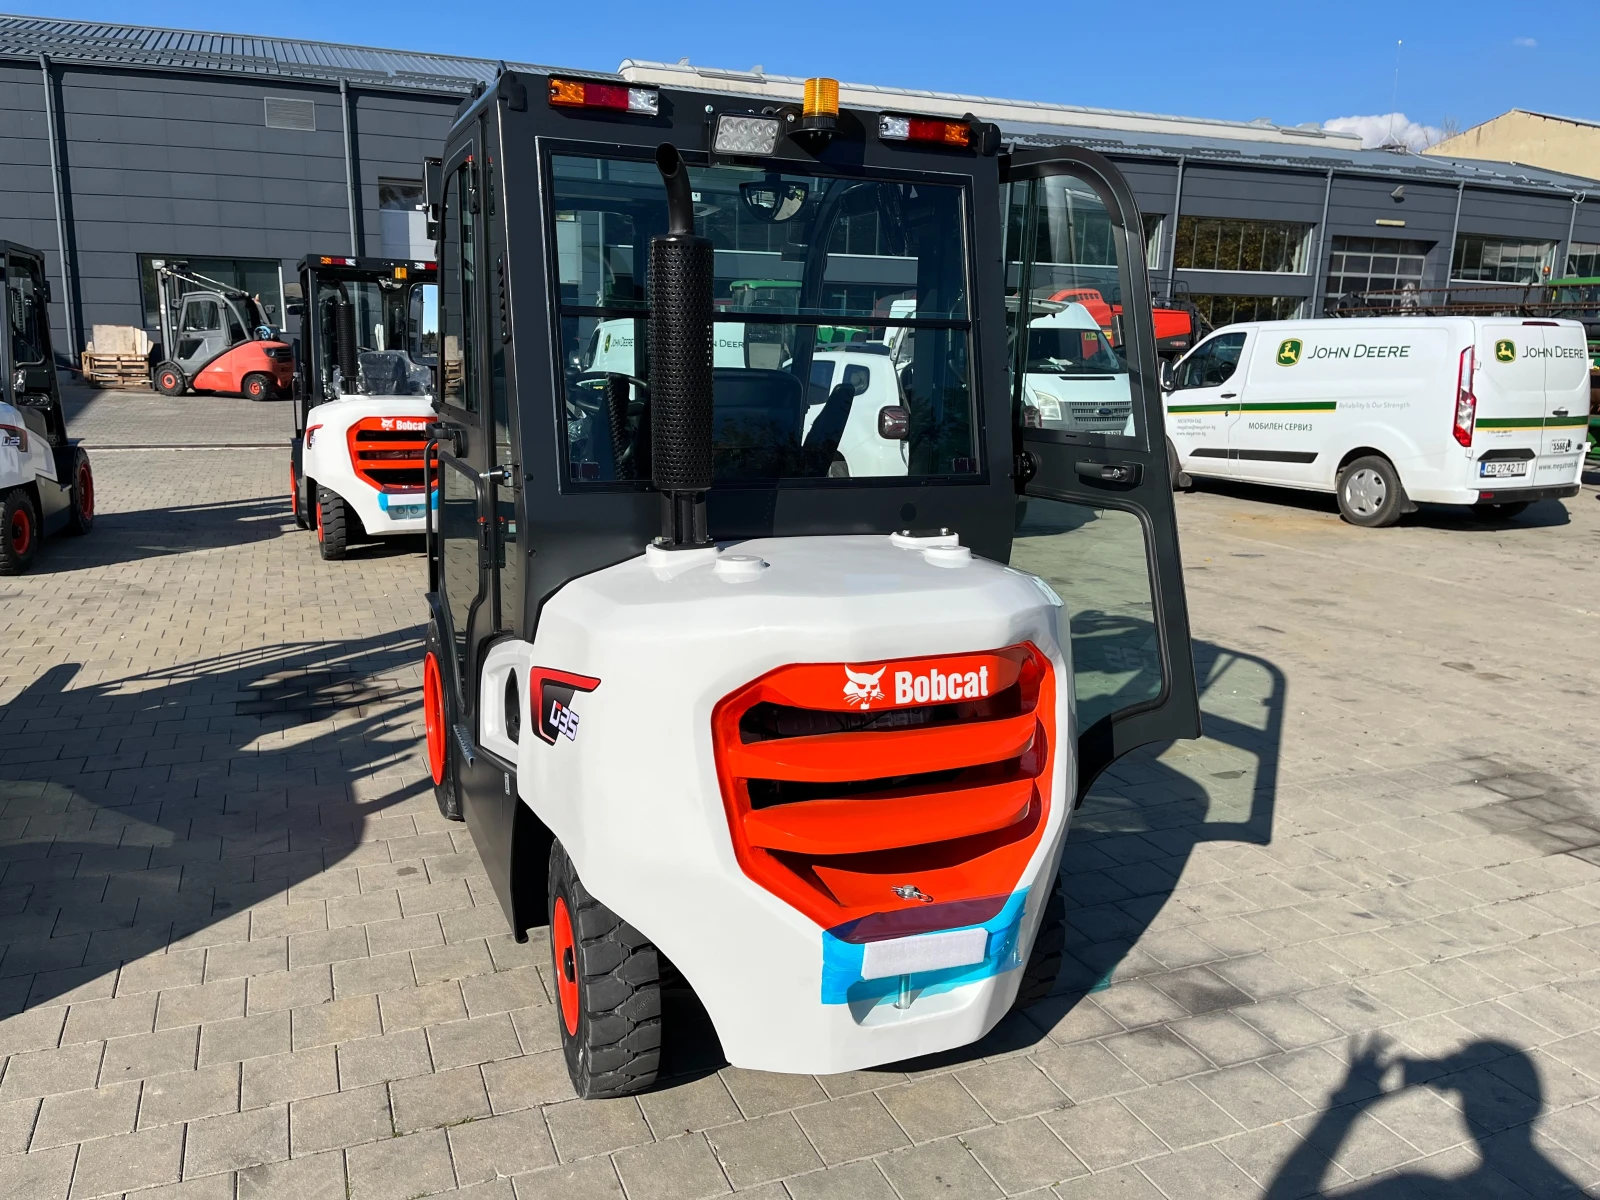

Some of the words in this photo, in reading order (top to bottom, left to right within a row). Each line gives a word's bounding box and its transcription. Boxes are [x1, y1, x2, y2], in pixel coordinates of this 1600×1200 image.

[719, 340, 745, 348] DEER
[1307, 345, 1351, 359] JOHN
[1353, 344, 1411, 358] DEERE
[1522, 345, 1553, 358] JOHN
[1555, 345, 1584, 359] DEERE
[1383, 401, 1411, 410] Strength
[396, 420, 427, 431] Bobcat
[1249, 422, 1284, 430] МОБИЛЕН
[1284, 422, 1313, 431] СЕРВИЗ
[1486, 464, 1496, 473] CB
[1497, 463, 1515, 473] 2742
[1516, 462, 1526, 472] TT
[894, 665, 989, 705] Bobcat
